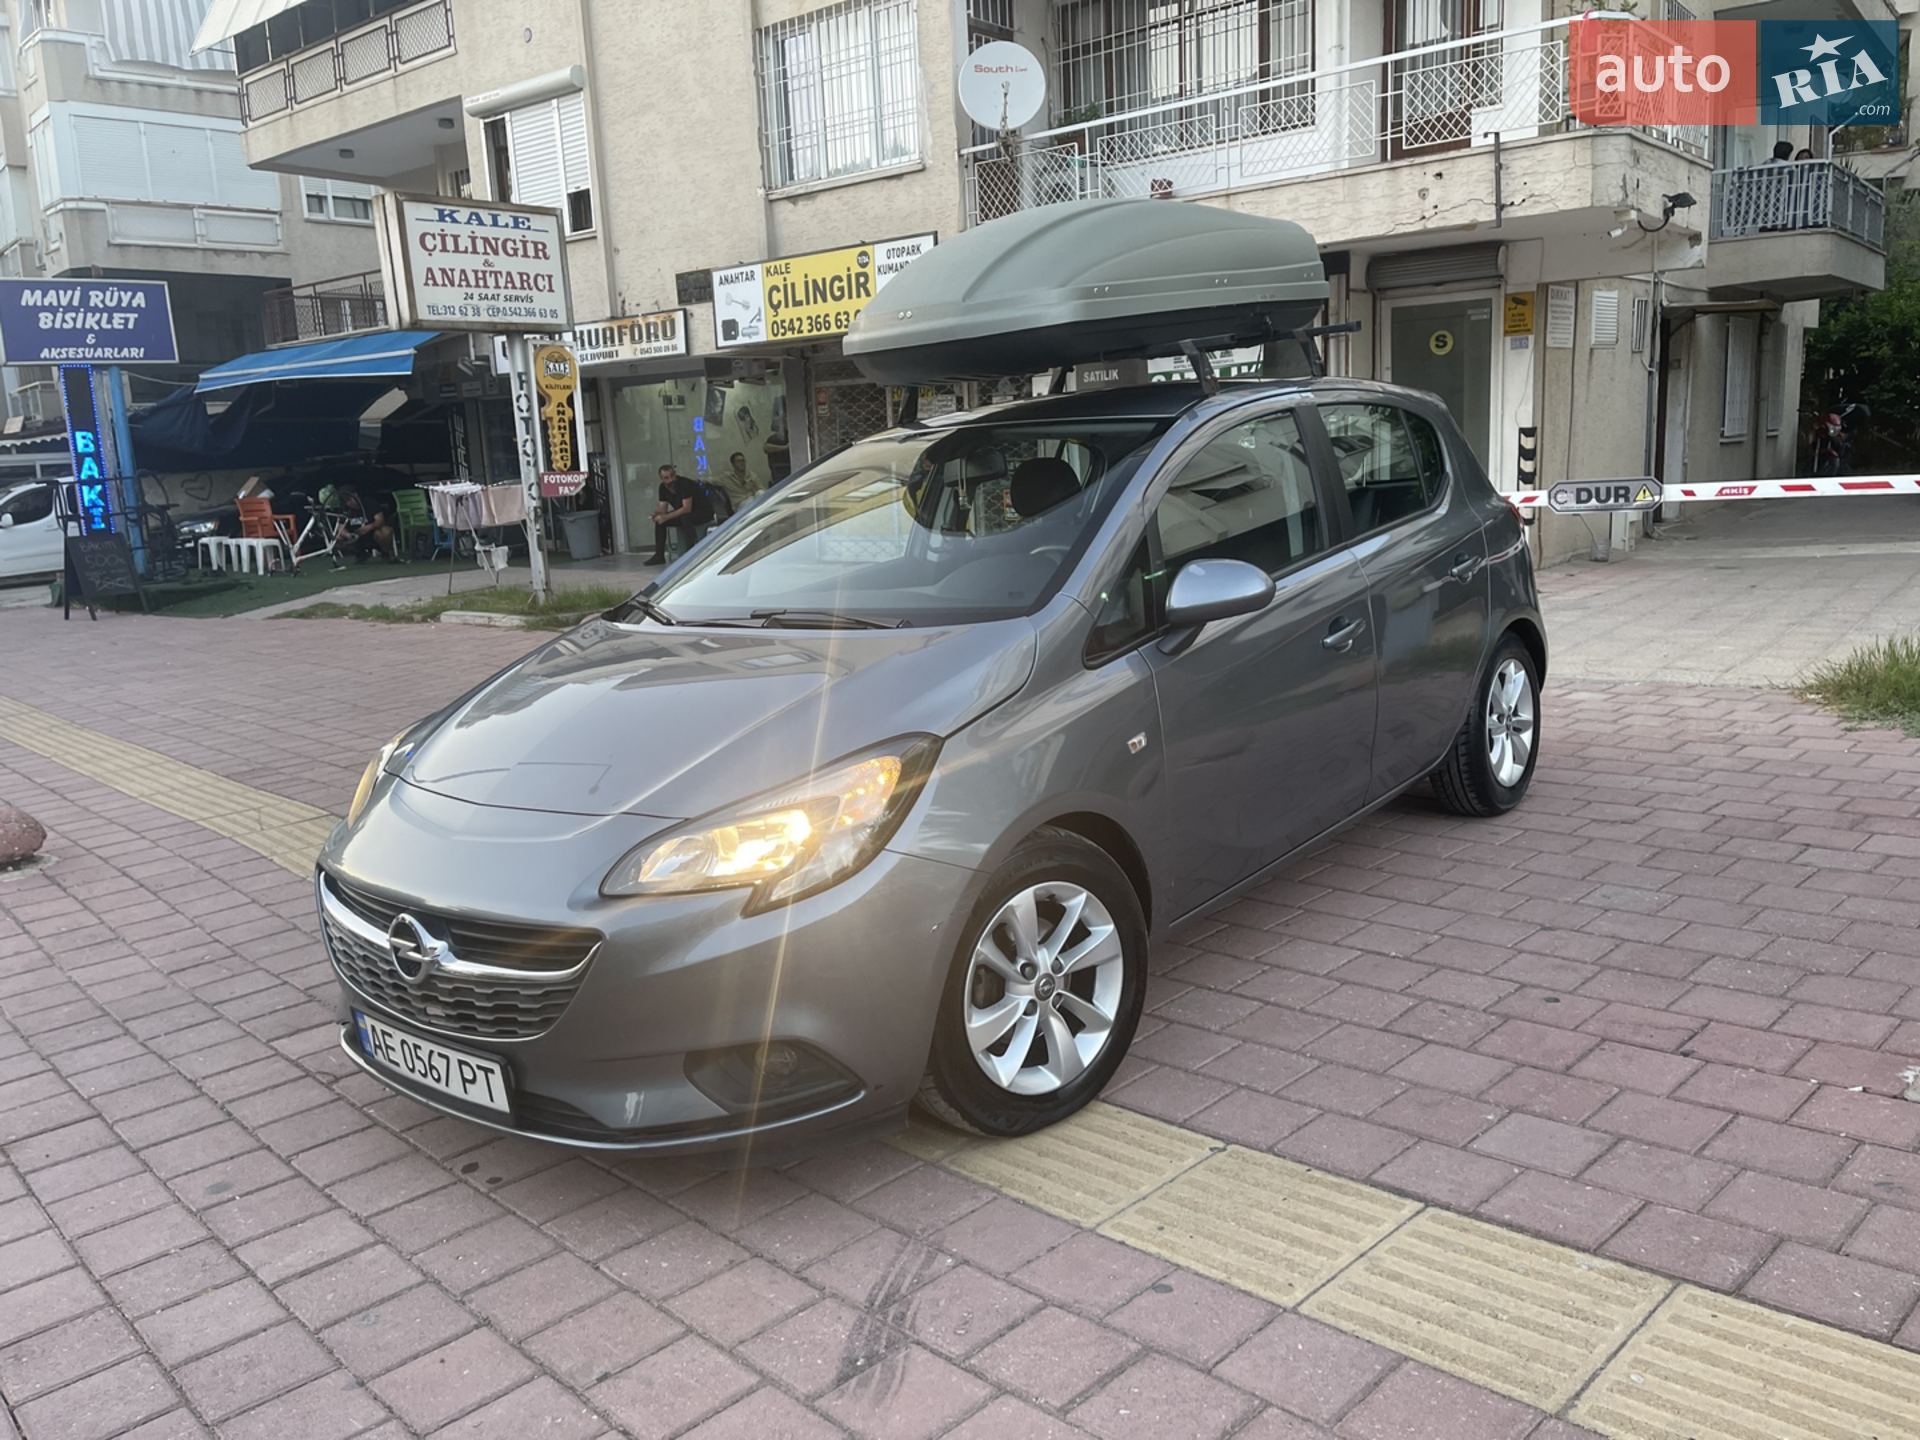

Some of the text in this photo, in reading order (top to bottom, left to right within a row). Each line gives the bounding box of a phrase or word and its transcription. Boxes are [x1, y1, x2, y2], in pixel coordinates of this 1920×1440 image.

[974, 64, 1014, 73] South
[433, 207, 532, 231] KALE
[419, 228, 550, 261] ÇİLİNGİR
[886, 243, 922, 260] OTOPARK
[482, 258, 495, 268] &
[765, 262, 791, 278] KALE
[423, 267, 555, 293] ANAHTARCI
[718, 270, 756, 287] ANAHTAR
[20, 286, 146, 308] MAVİ RÜYA
[463, 292, 534, 304] 24 SAAT SERVİS
[767, 266, 872, 317] ÇİLİNGİR
[38, 308, 139, 331] BİSİKLET
[458, 305, 469, 317] 62
[471, 306, 481, 317] 38
[538, 308, 548, 318] 63
[549, 308, 558, 319] 05
[771, 316, 804, 338] 0542
[806, 313, 831, 333] 366
[86, 333, 96, 345] &
[40, 347, 145, 360] AKSESUARLARI
[545, 360, 570, 374] KALE
[1083, 368, 1119, 383] SATILIK
[555, 401, 570, 470] ANAHTARCI
[1575, 485, 1631, 504] DUR
[370, 1023, 495, 1103] AE 0567 PT
